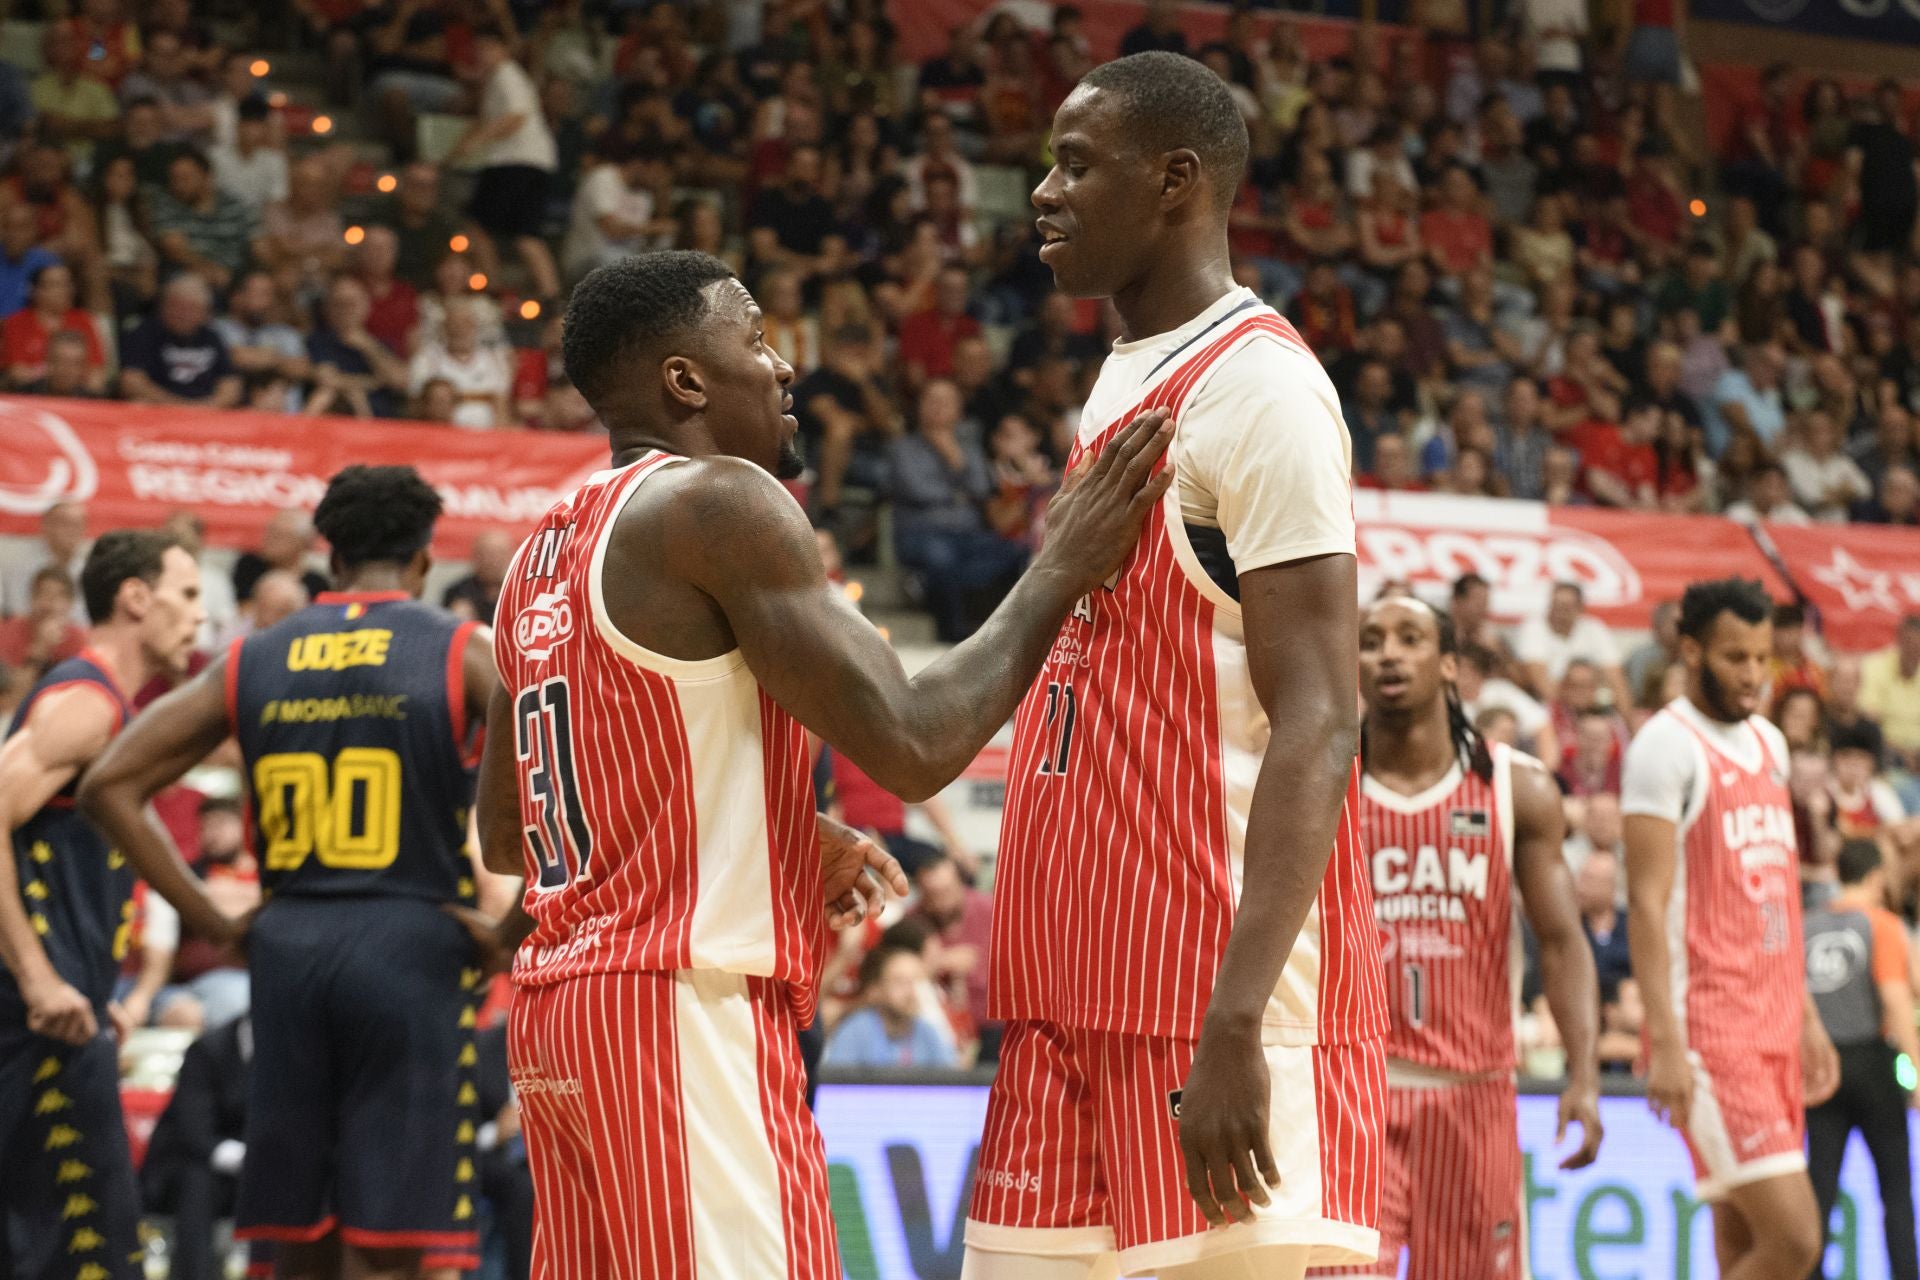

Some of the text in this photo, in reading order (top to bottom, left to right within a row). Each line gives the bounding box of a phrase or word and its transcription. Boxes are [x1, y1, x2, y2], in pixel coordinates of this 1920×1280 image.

[287, 628, 393, 672] UDEZE
[253, 747, 401, 871] 00
[514, 675, 593, 894] 31
[1365, 845, 1489, 901] CAM
[1403, 962, 1425, 1031] 1
